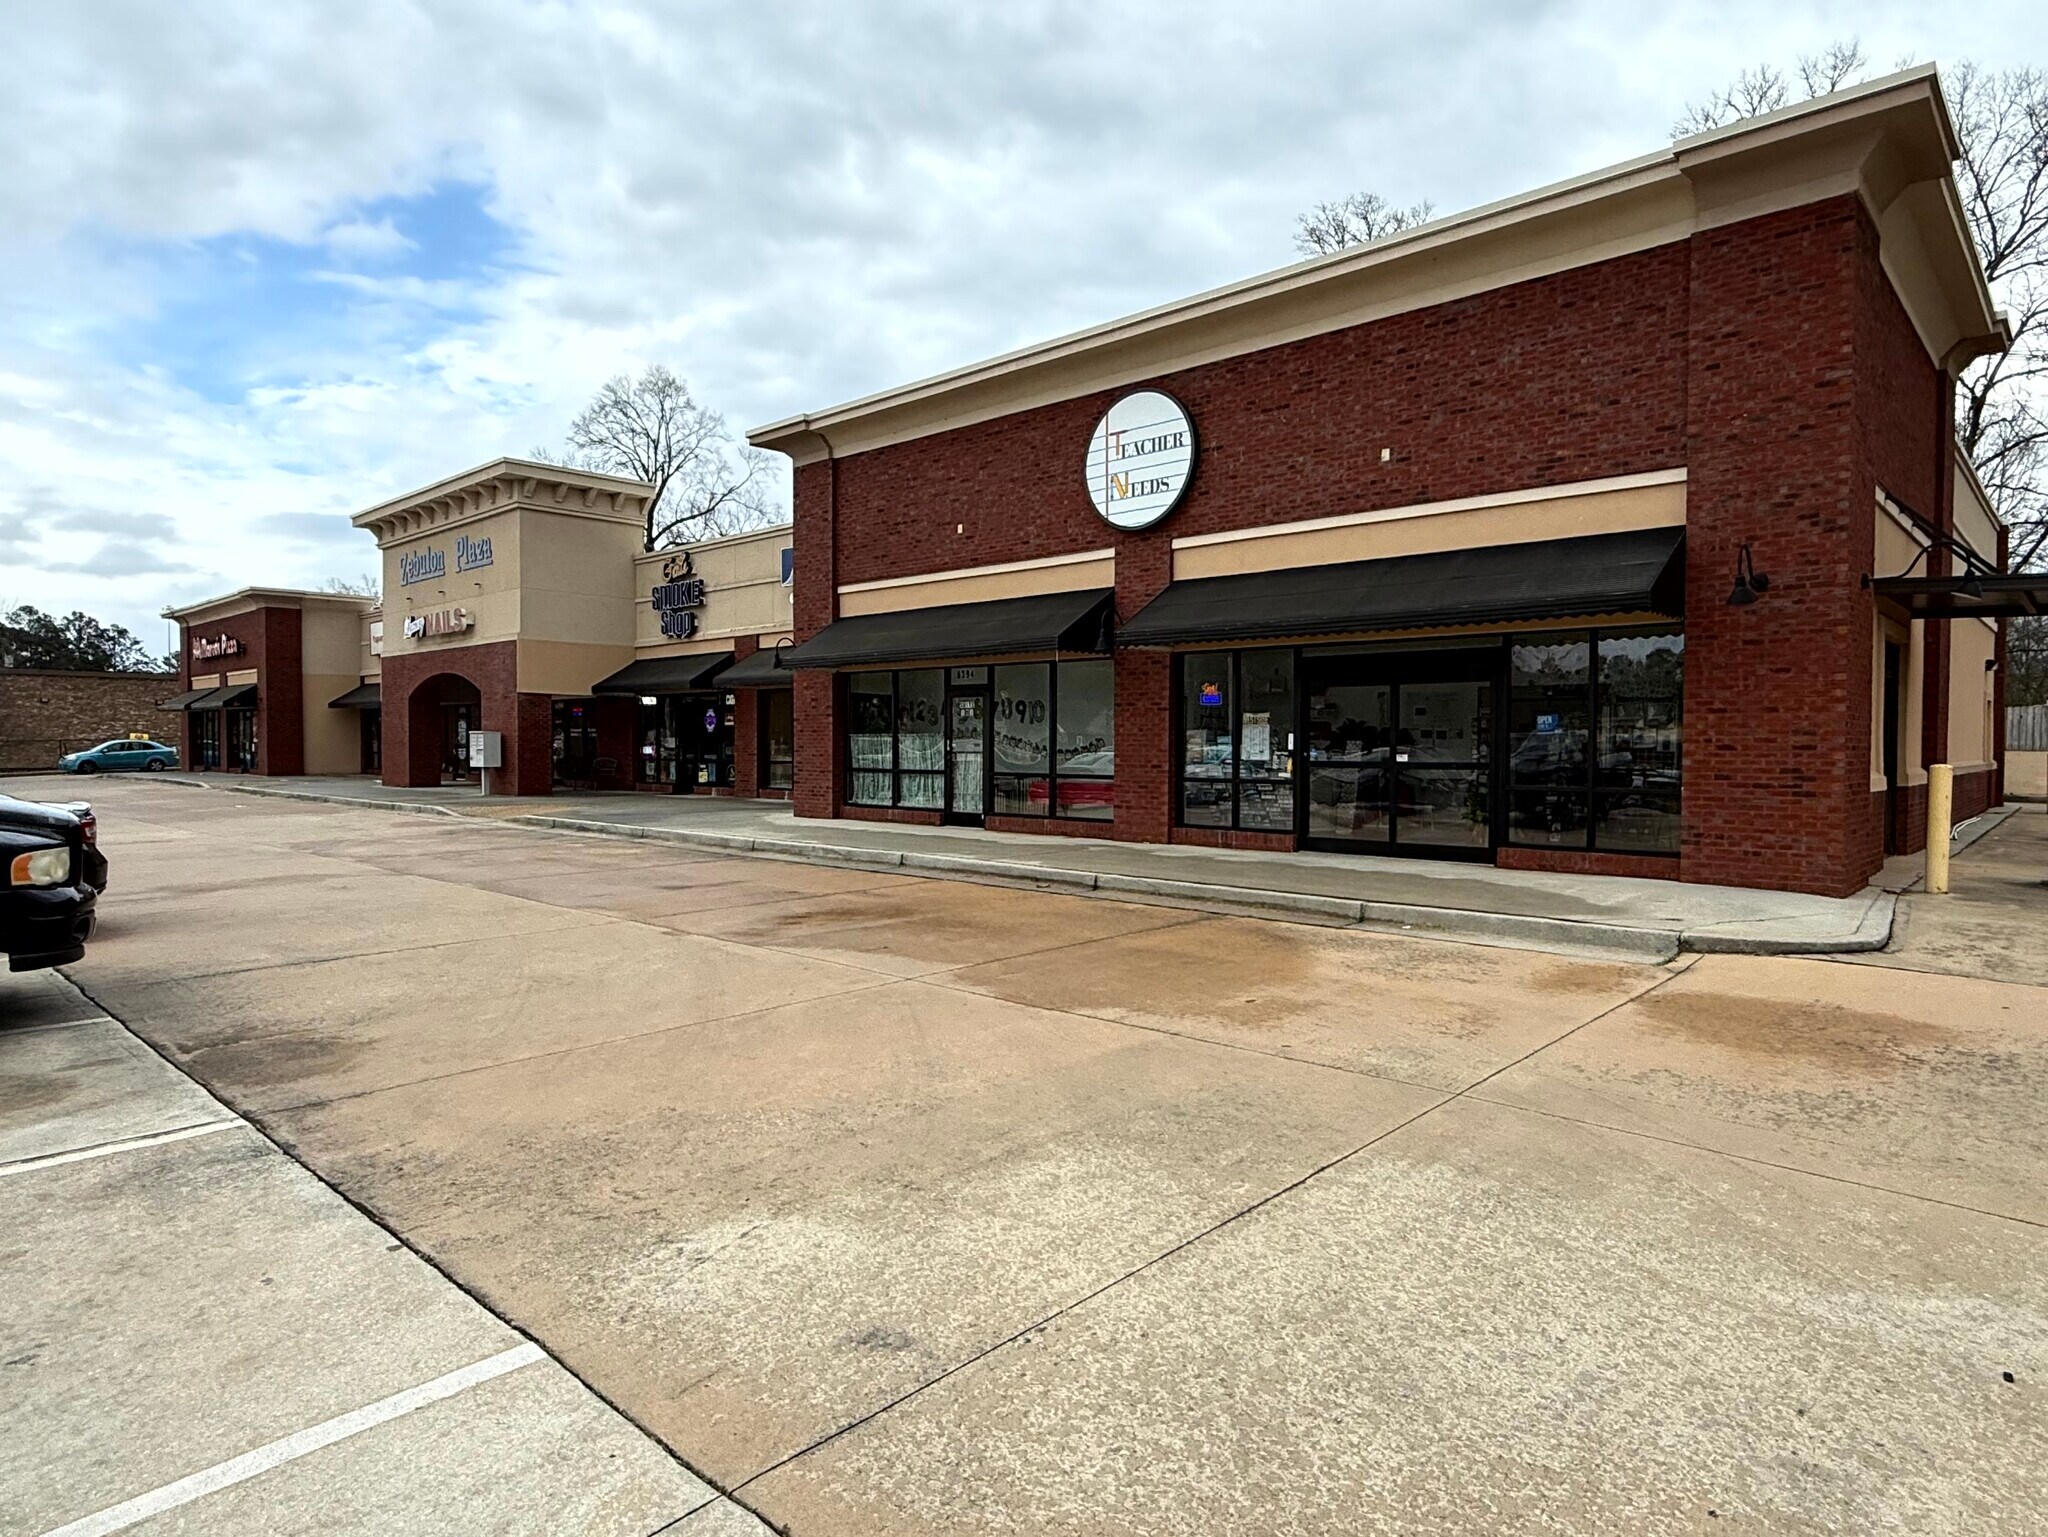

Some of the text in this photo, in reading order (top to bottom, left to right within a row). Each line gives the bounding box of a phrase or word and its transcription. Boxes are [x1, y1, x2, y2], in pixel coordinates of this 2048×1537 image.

[1109, 429, 1185, 460] TEACHER
[1110, 471, 1171, 501] NEEDS
[400, 535, 493, 586] Zebulon Plaza
[425, 607, 467, 638] NAILS
[661, 609, 691, 639] Shop
[1536, 715, 1552, 724] OPEN
